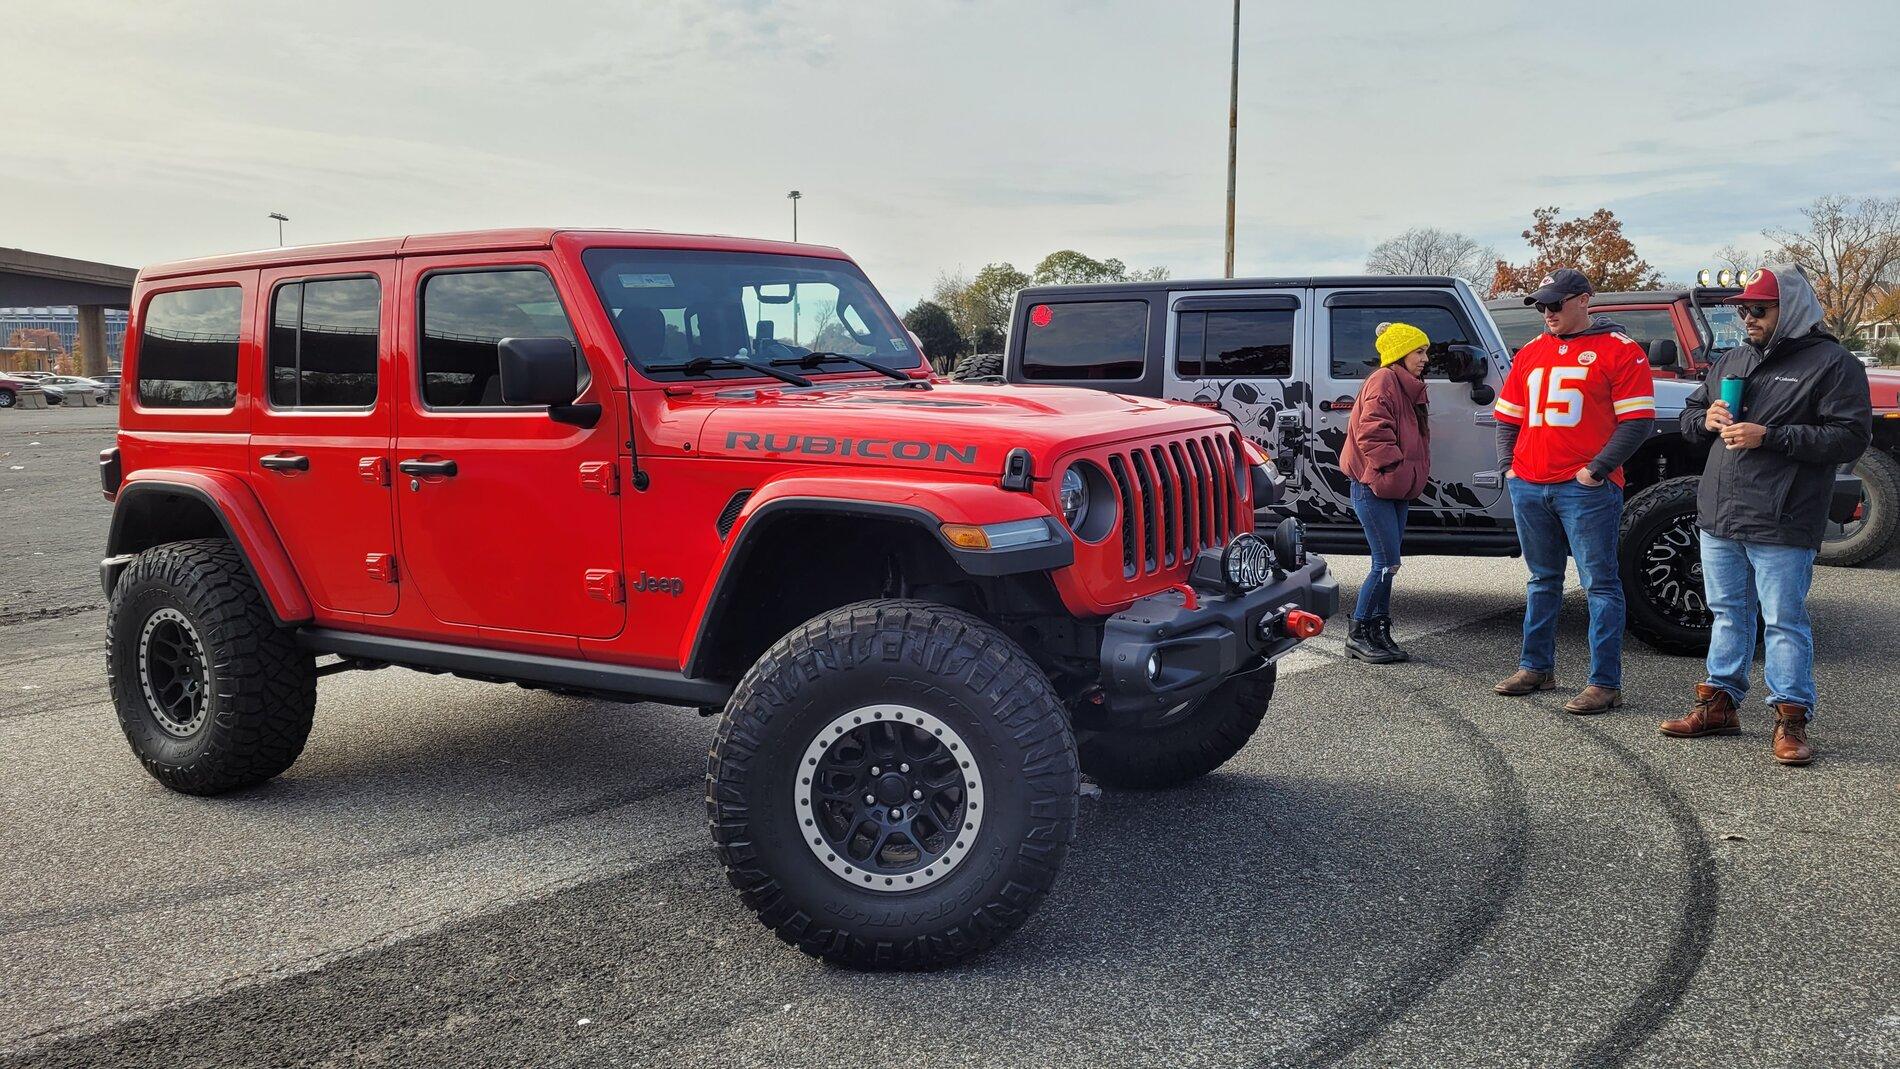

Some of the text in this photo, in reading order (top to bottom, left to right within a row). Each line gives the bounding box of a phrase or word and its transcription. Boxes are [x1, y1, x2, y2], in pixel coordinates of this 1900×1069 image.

[1527, 366, 1589, 428] 15
[725, 431, 978, 464] RUBICON
[633, 570, 684, 597] Jeep
[1240, 541, 1272, 587] KC
